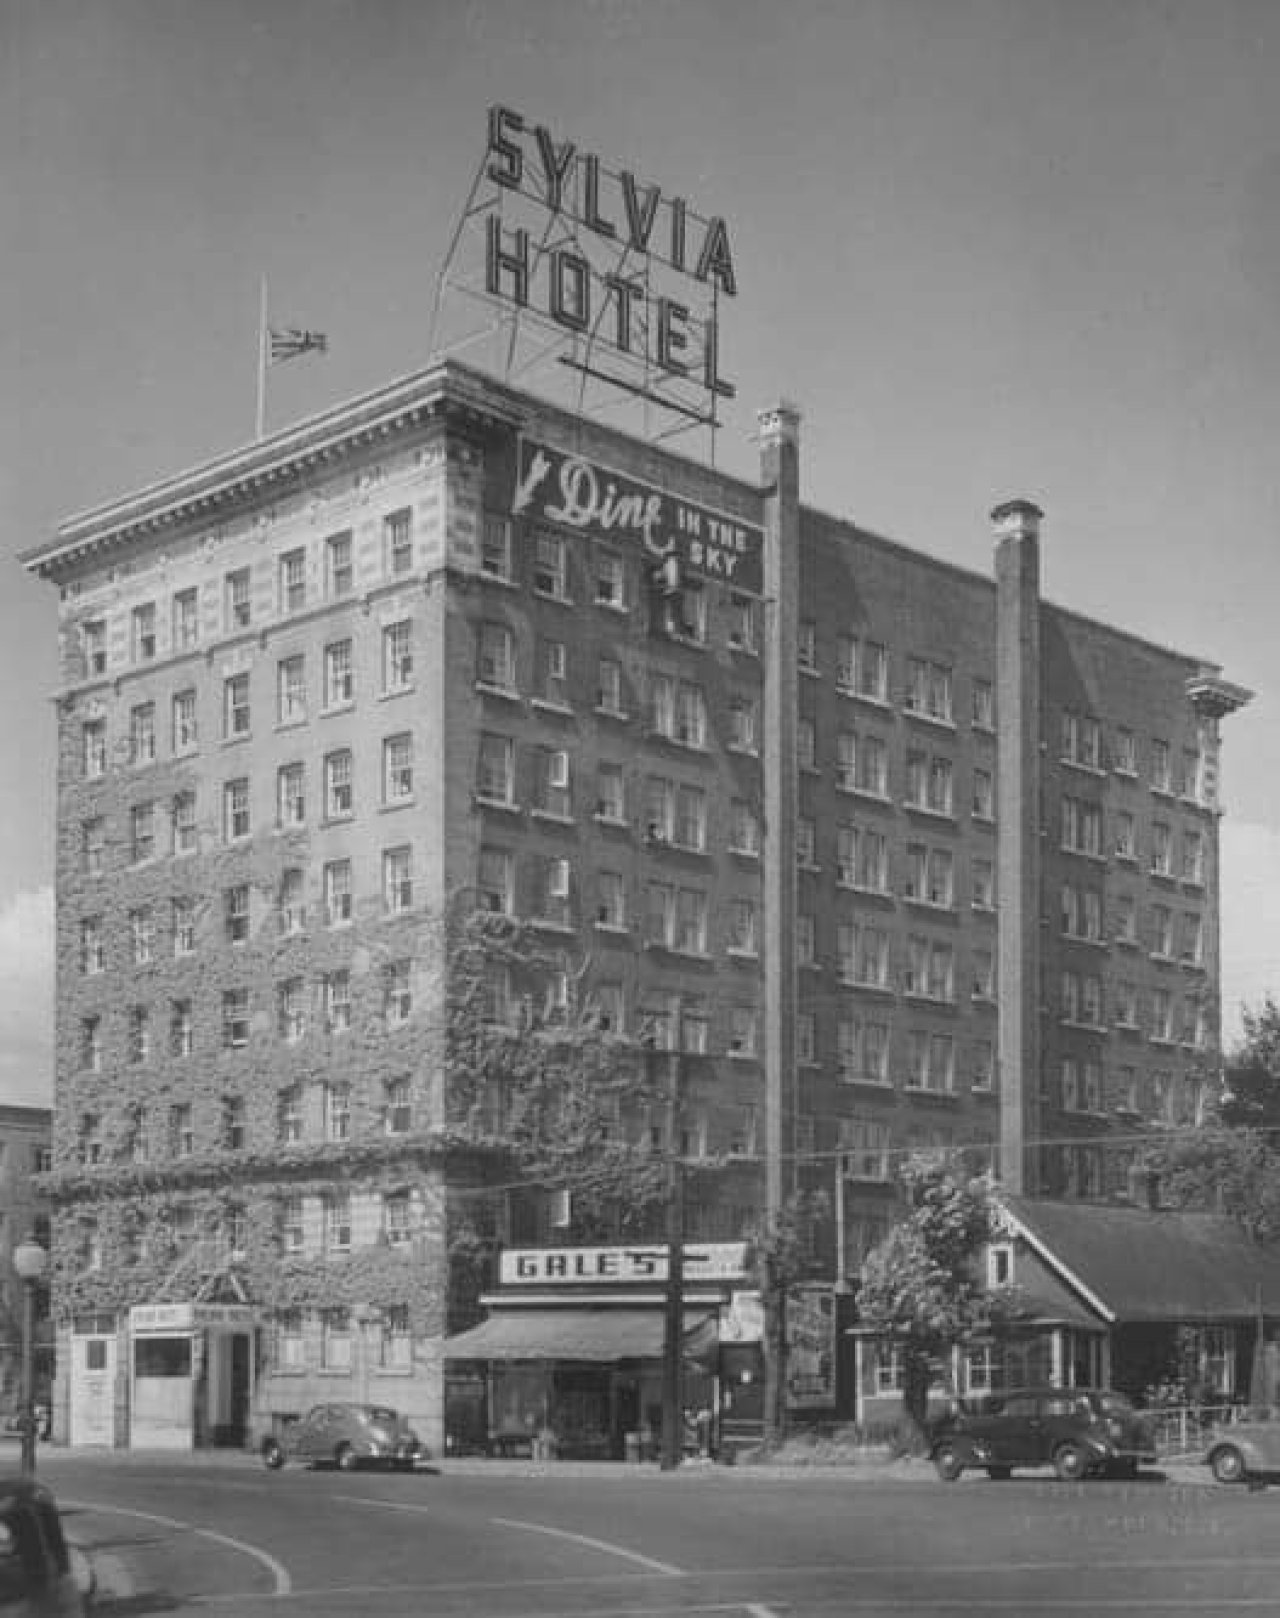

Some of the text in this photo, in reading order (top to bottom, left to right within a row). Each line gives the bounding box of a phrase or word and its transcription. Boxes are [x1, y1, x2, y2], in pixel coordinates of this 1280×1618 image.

[487, 105, 736, 296] SYLVIA
[486, 213, 736, 398] HOTEL
[544, 457, 676, 555] Dine
[679, 506, 746, 552] IN THE
[690, 541, 736, 576] SKY
